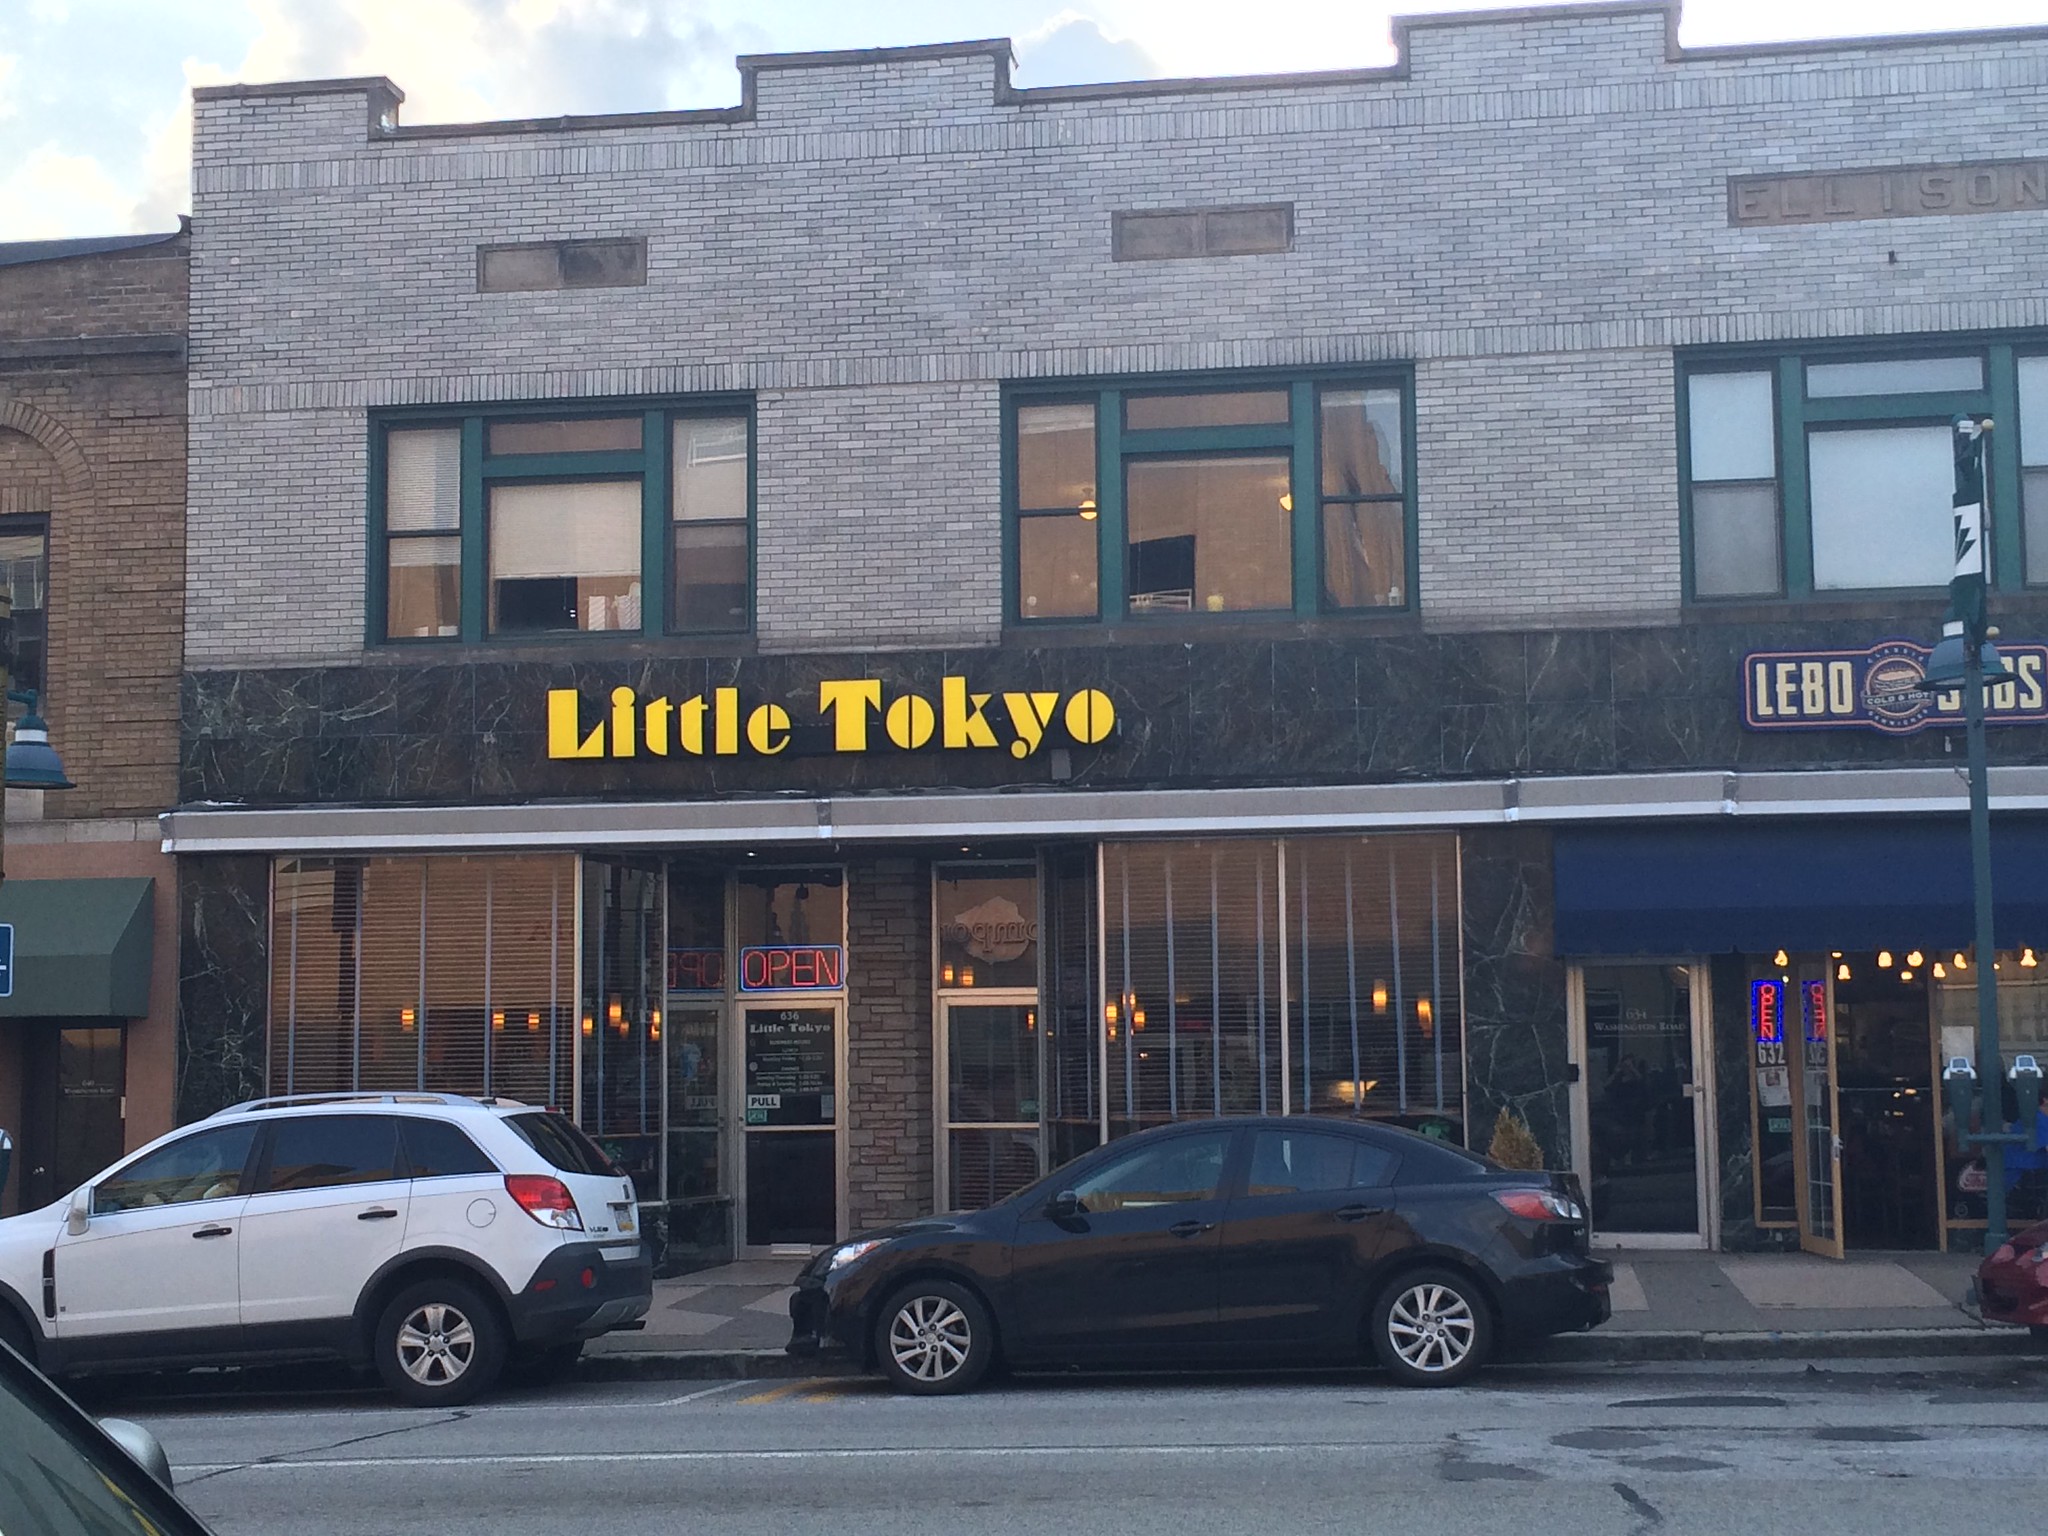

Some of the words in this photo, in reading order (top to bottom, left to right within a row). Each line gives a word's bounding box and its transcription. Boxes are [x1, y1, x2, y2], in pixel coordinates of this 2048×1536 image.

[1736, 164, 2047, 220] ELLISON
[1755, 661, 1854, 716] LEBO
[1866, 695, 1896, 706] COLD
[1907, 692, 1929, 700] HOT
[548, 686, 791, 759] Little
[819, 675, 1115, 760] Tokyo
[743, 950, 839, 987] OPEN
[780, 1011, 800, 1021] 636
[1760, 983, 1775, 1041] OPEN
[749, 1023, 785, 1034] Little
[788, 1022, 831, 1034] Tokyo
[1757, 1041, 1786, 1065] 632
[751, 1096, 777, 1107] PULL
